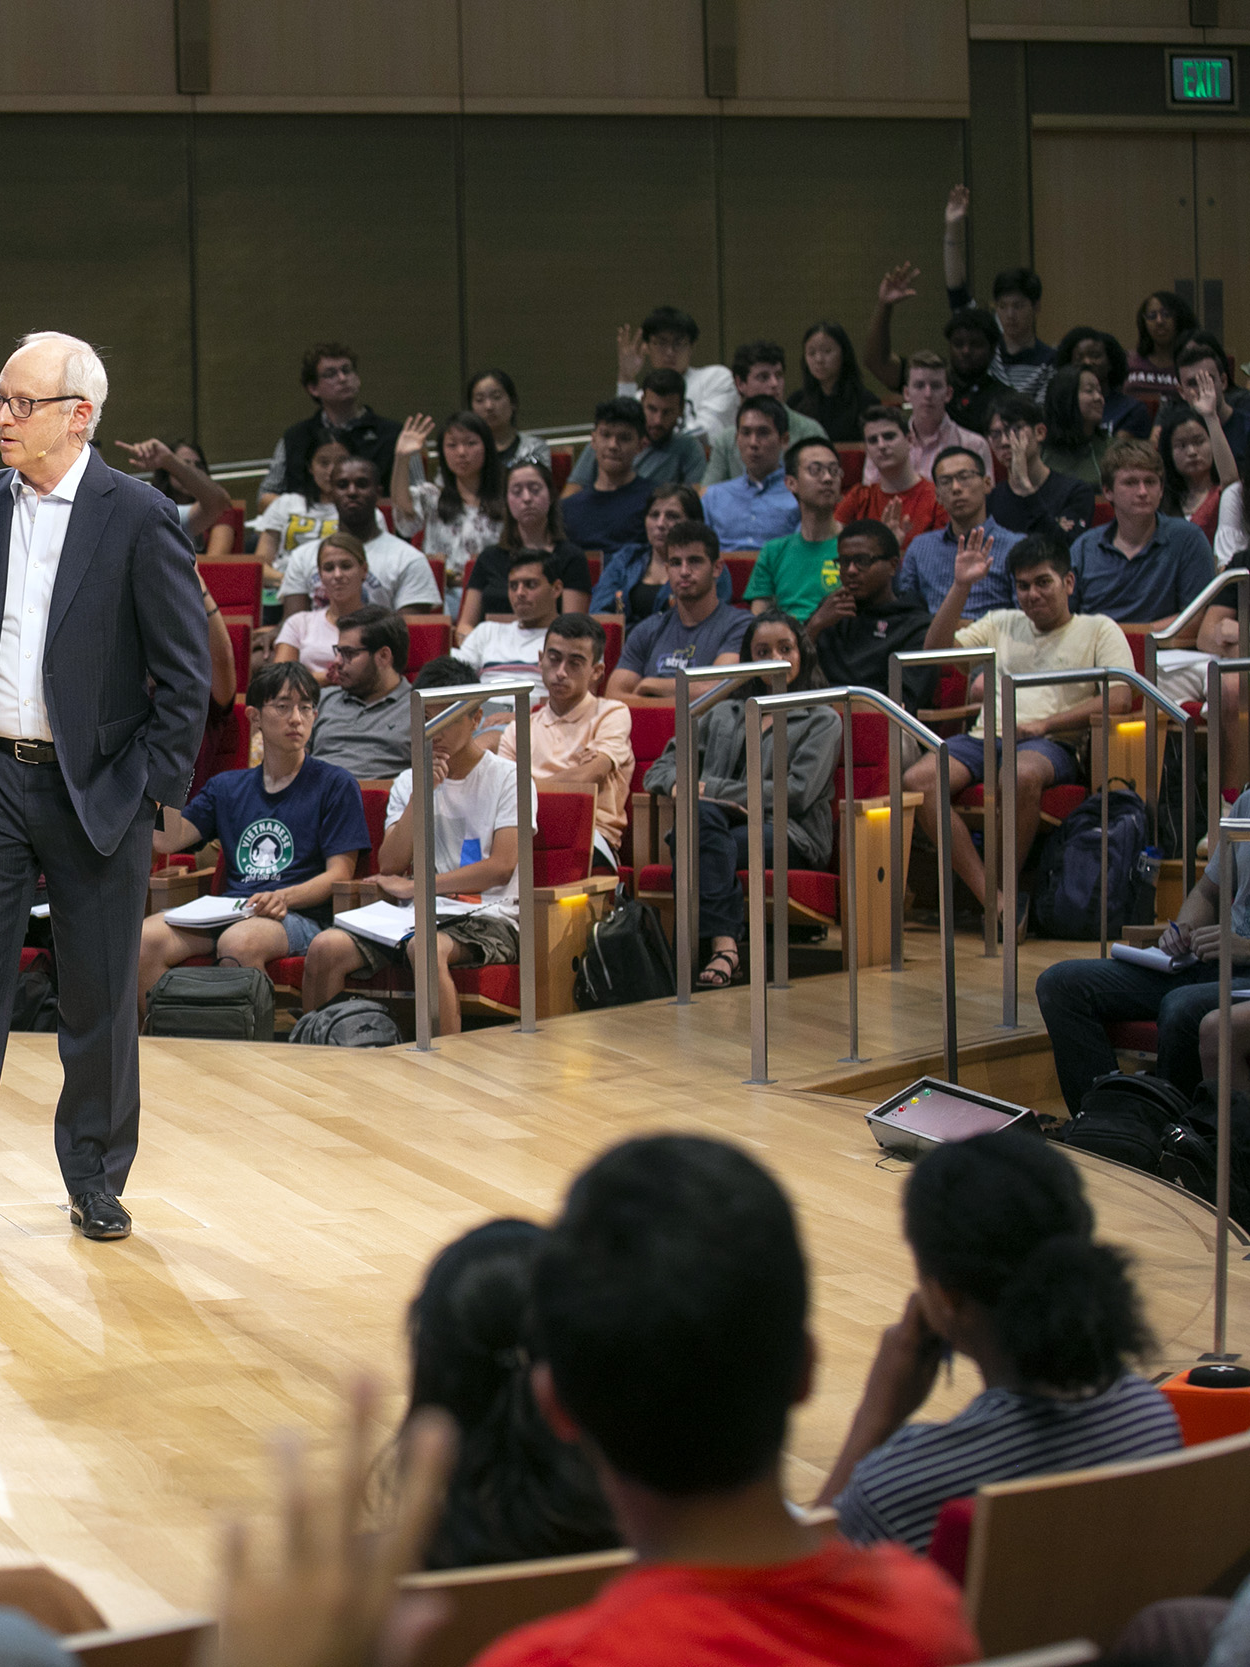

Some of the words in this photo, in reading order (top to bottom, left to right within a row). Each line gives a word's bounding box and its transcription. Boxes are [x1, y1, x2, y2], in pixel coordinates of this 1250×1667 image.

[1182, 60, 1223, 98] EXIT
[241, 822, 291, 849] VIETNAMESE
[245, 864, 278, 875] COFFEE
